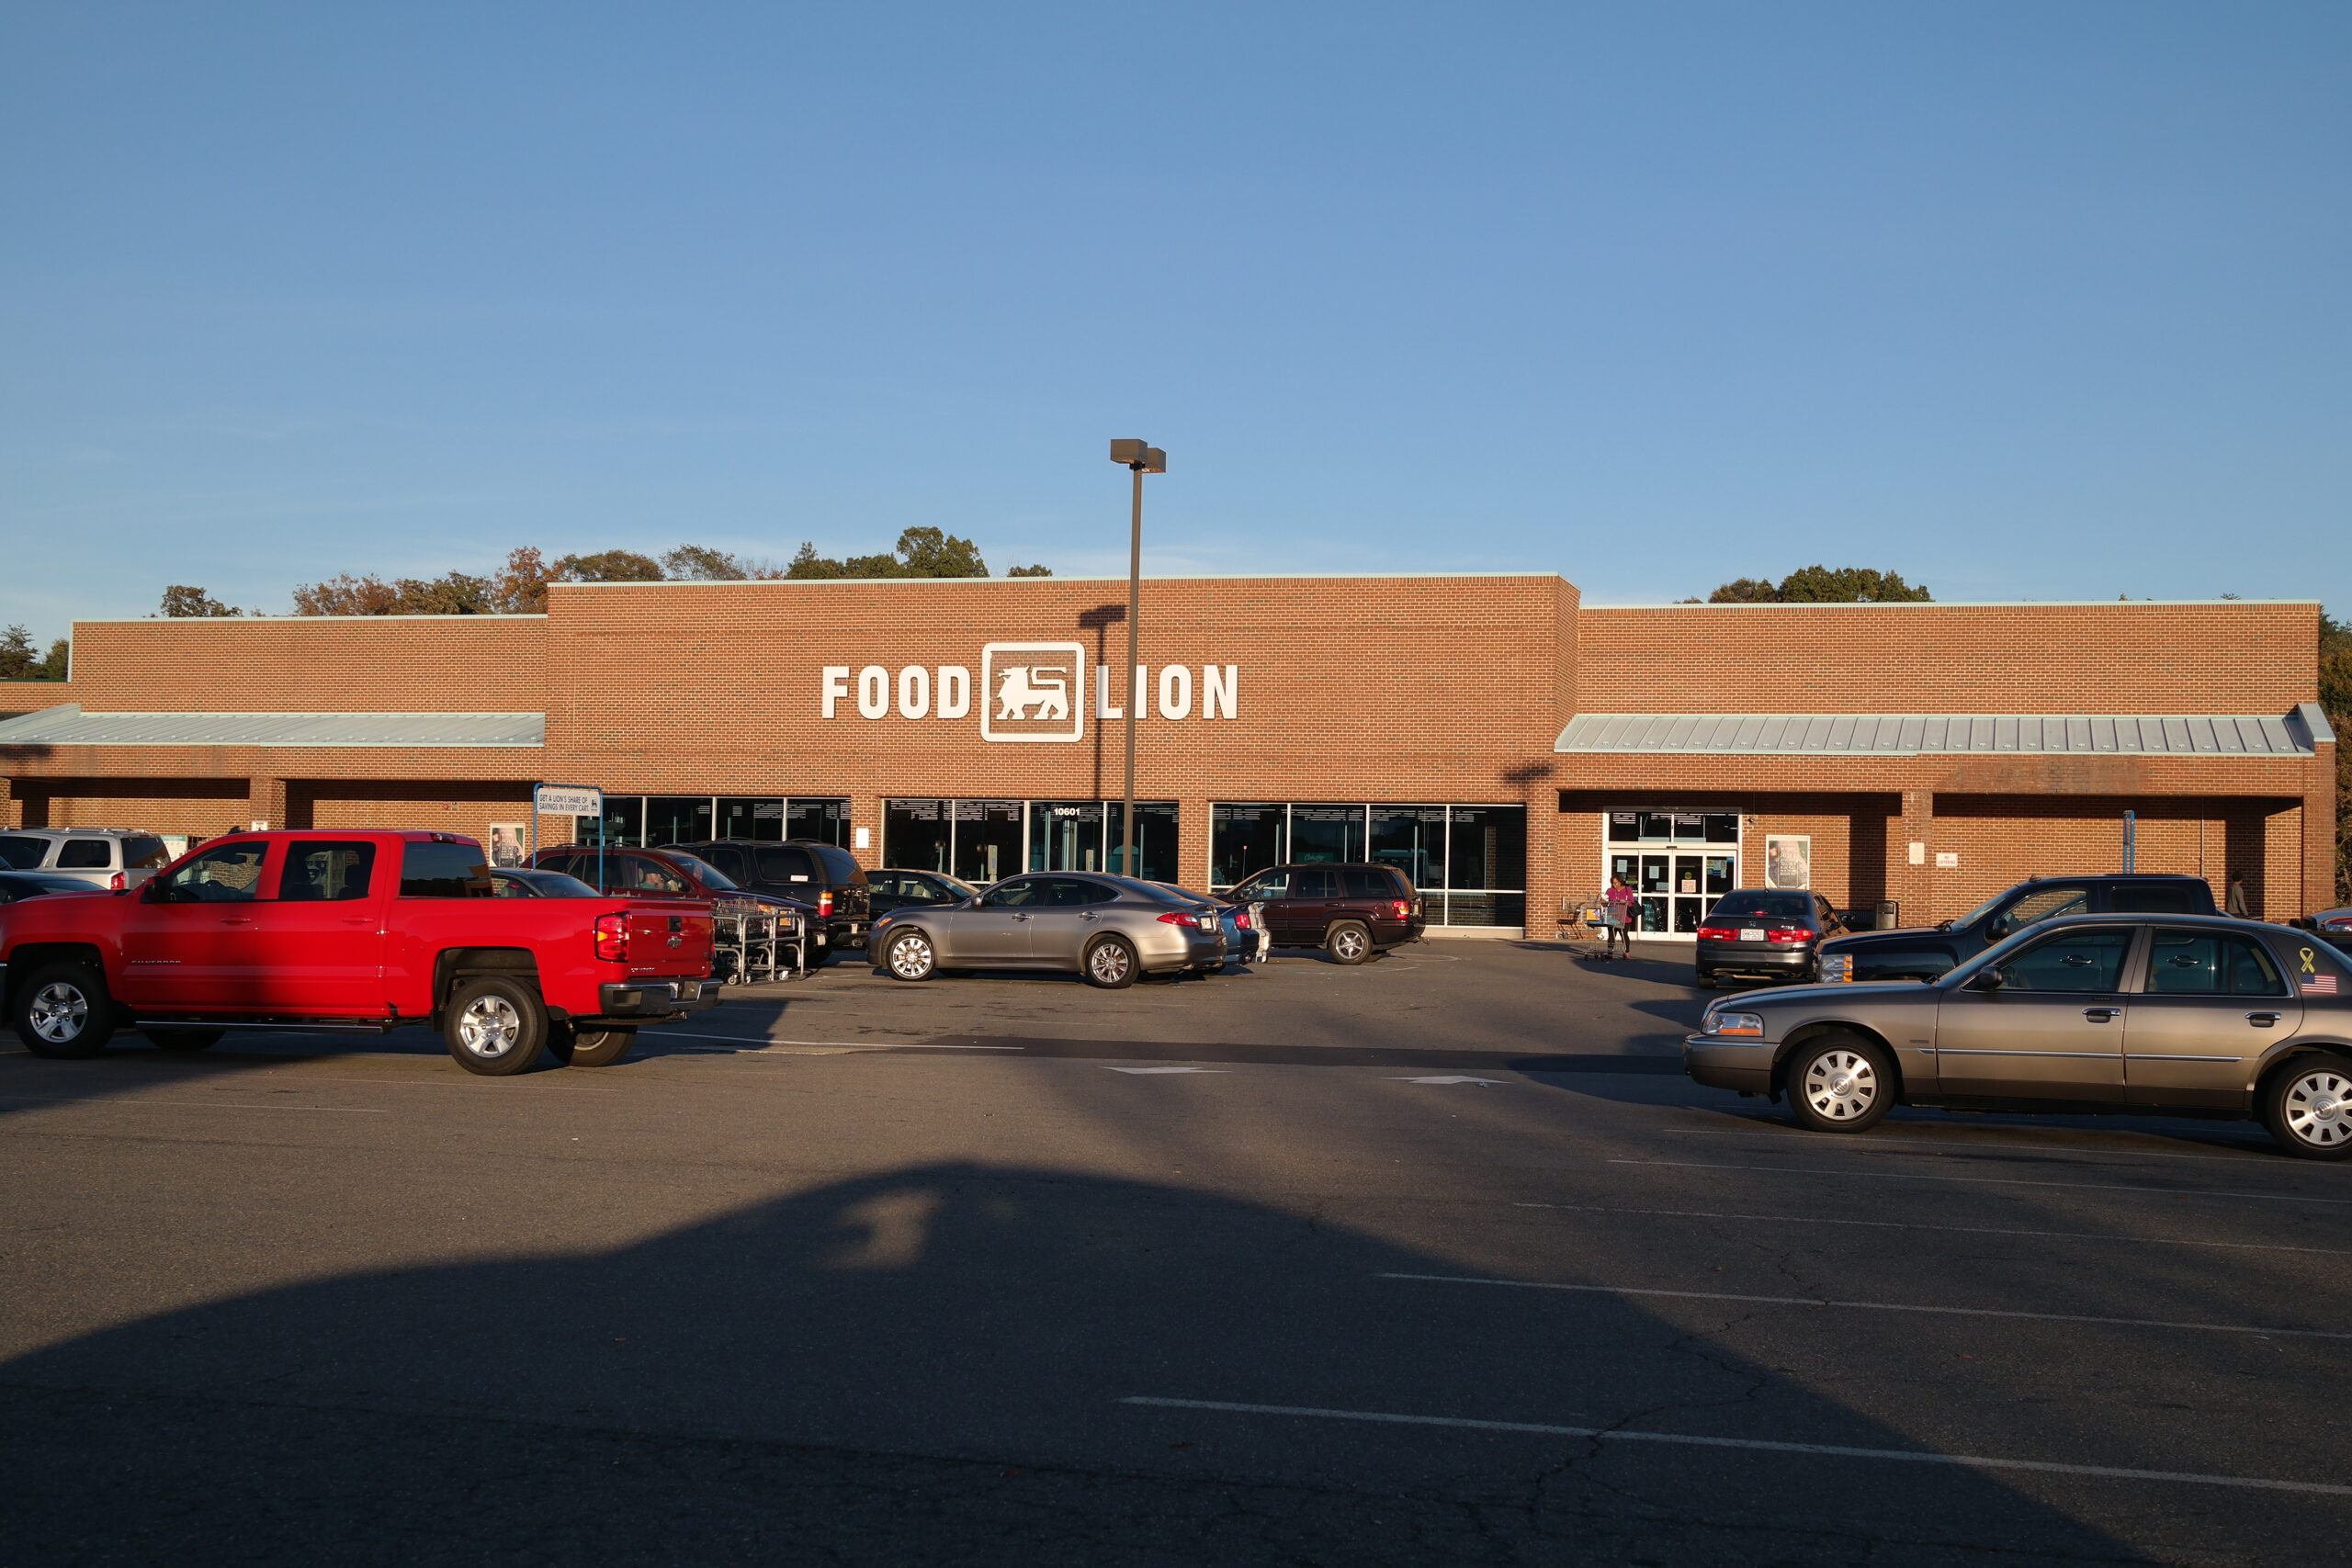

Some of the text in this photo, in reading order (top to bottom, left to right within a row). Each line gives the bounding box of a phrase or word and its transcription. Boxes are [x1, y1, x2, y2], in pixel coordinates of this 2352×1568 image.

[821, 663, 1238, 720] FOOD LION
[568, 795, 581, 804] SHARE
[565, 804, 578, 812] EVERY
[1054, 807, 1080, 816] 10601
